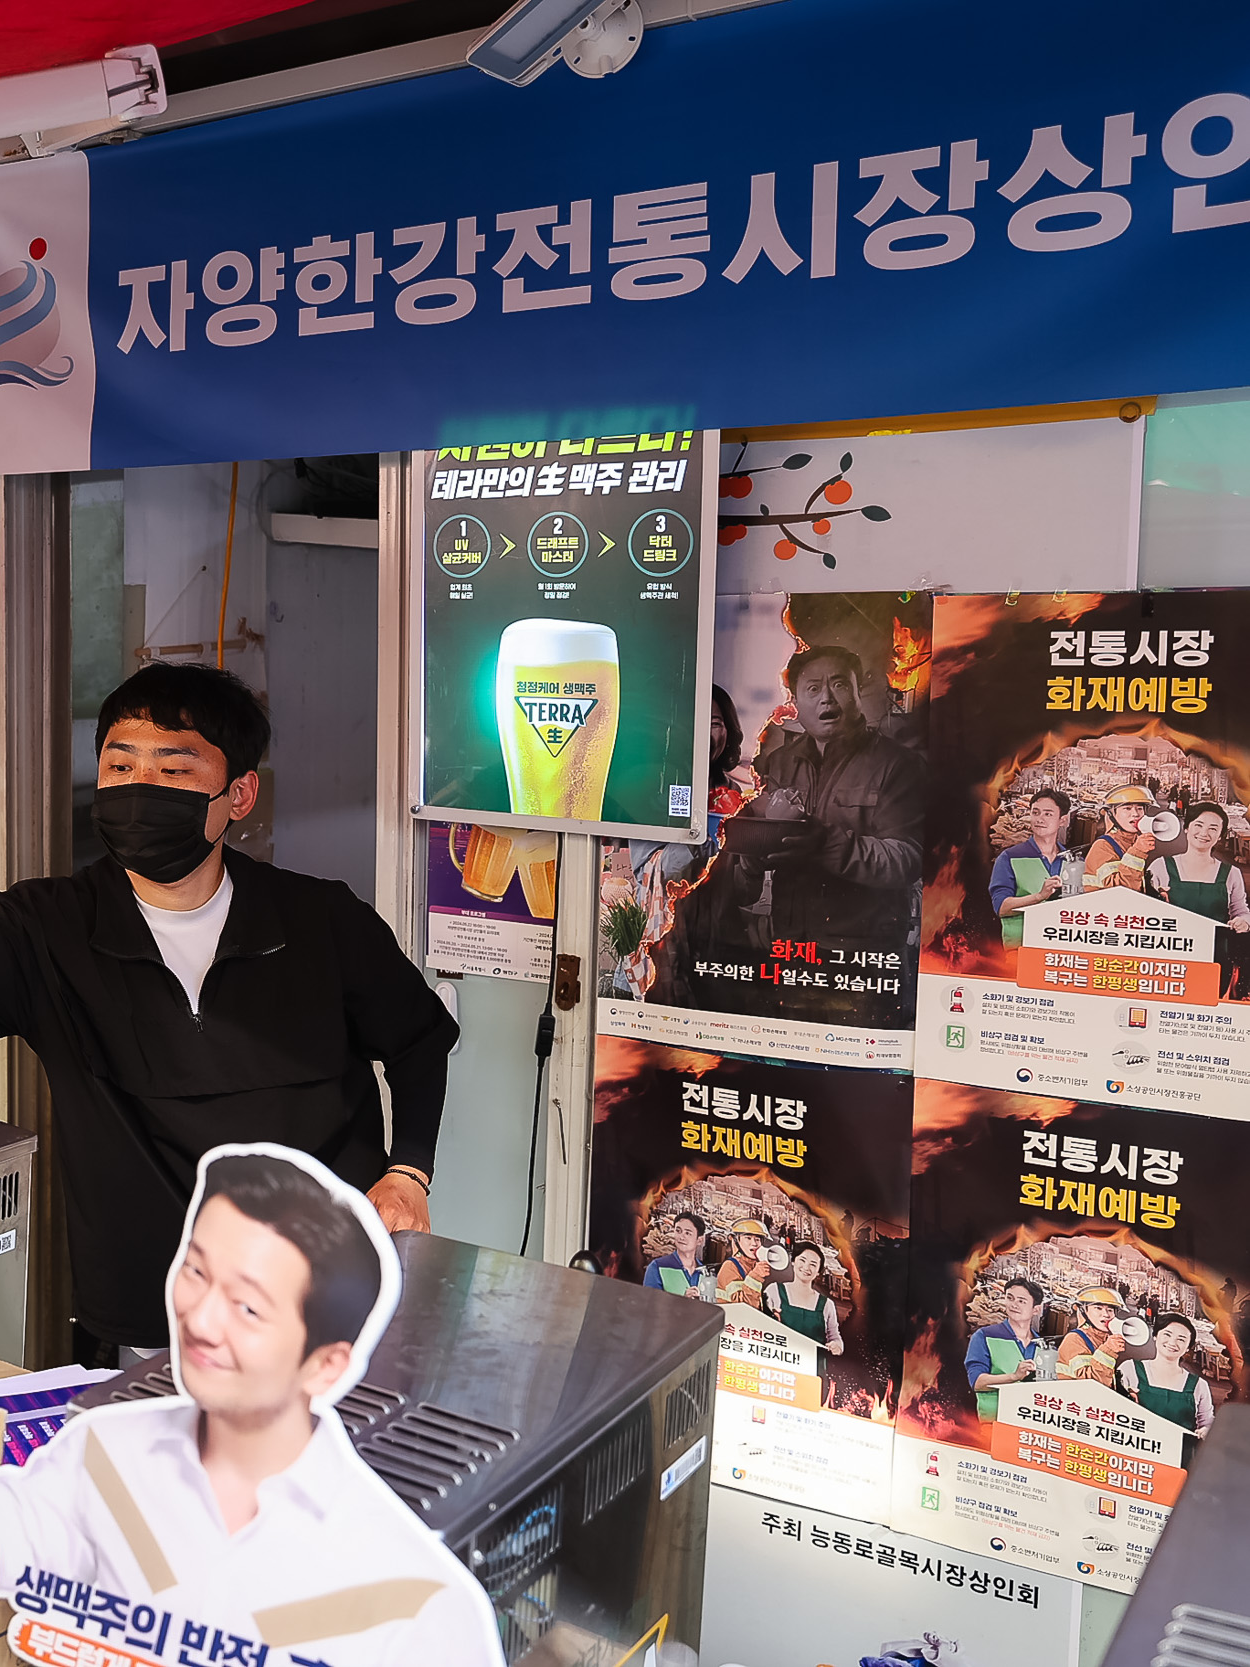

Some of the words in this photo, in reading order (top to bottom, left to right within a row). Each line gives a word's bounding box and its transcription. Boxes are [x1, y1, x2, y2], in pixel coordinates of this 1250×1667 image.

[568, 462, 625, 495] 맥주
[627, 459, 688, 494] 관리
[459, 520, 467, 537] 1
[553, 517, 563, 535] 2
[655, 515, 666, 533] 3
[454, 539, 469, 551] UV
[536, 537, 580, 550] 드래프트
[648, 535, 673, 548] 닥터
[442, 551, 482, 565] 살균커버
[541, 550, 574, 563] 마스터
[642, 549, 677, 562] 드링크
[1048, 629, 1214, 667] 전통시장
[516, 681, 560, 695] 청정케어
[562, 682, 597, 695] 생맥주
[1045, 676, 1212, 714] 화재예방
[524, 702, 585, 726] TERRA
[546, 728, 563, 744] 生
[1059, 910, 1090, 926] 일상
[1094, 913, 1109, 928] 속
[1113, 915, 1178, 932] 실천으로
[1042, 927, 1120, 947] 우리시장을
[1124, 932, 1194, 953] 지킵시다!
[769, 938, 823, 966] 화재,
[829, 950, 846, 965] 그
[850, 951, 902, 969] 시작은
[1044, 952, 1089, 969] 화재는
[1093, 956, 1187, 979] 한순간이지만
[693, 960, 755, 982] 부주의한
[759, 962, 829, 989] 나일수도
[833, 974, 901, 995] 있습니다
[1044, 970, 1088, 988] 복구는
[1092, 974, 1186, 996] 한평생입니다
[982, 992, 1004, 1002] 소화기
[1006, 994, 1013, 1002] 및
[1015, 995, 1037, 1005] 경보기
[1039, 998, 1054, 1007] 점검
[709, 1021, 729, 1029] meritz
[1159, 1009, 1184, 1020] 전열기
[1186, 1012, 1194, 1021] 및
[1196, 1013, 1213, 1023] 화기
[1215, 1015, 1232, 1025] 주의
[980, 1030, 1002, 1040] 비상구
[1003, 1033, 1018, 1041] 점검
[1029, 1035, 1045, 1044] 확보
[1157, 1050, 1173, 1059] 전선
[1175, 1052, 1184, 1060] 및
[1185, 1053, 1211, 1063] 스위치
[1212, 1056, 1230, 1065] 점검
[1037, 1073, 1088, 1087] 중소벤처기업부
[1126, 1084, 1201, 1102] 소상공인시장진흥공단
[682, 1081, 807, 1131] 전통시장
[681, 1120, 807, 1168] 화재예방
[1022, 1129, 1184, 1186] 전통시장
[1018, 1173, 1181, 1230] 화재예방
[724, 1322, 736, 1336] 속
[738, 1325, 788, 1348] 실천으로
[747, 1343, 801, 1365] 지킵시다!
[724, 1359, 796, 1387] 한순간이지만
[724, 1375, 796, 1402] 한평생입니다
[1033, 1392, 1063, 1412] 일상
[1066, 1401, 1082, 1417] 속
[1085, 1405, 1147, 1434] 실천으로
[1016, 1406, 1091, 1436] 우리시장을
[1094, 1425, 1162, 1455] 지킵시다!
[1018, 1430, 1062, 1454] 화재는
[1065, 1442, 1156, 1479] 한순간이지만
[957, 1460, 979, 1471] 소화기
[989, 1468, 1011, 1479] 경보기
[1012, 1473, 1028, 1483] 점검
[1017, 1447, 1061, 1471] 복구는
[1063, 1459, 1154, 1496] 한평생입니다
[955, 1495, 977, 1507] 비상구
[977, 1501, 992, 1511] 점검
[993, 1505, 1001, 1513] 및
[1002, 1507, 1018, 1517] 확보
[1128, 1504, 1153, 1518] 전열기
[1010, 1545, 1060, 1564] 중소벤처기업부
[1126, 1541, 1143, 1552] 전선
[761, 1511, 803, 1541] 주최
[810, 1524, 1040, 1609] 능동로골목시장상인회
[15, 1565, 172, 1656] 생맥주의
